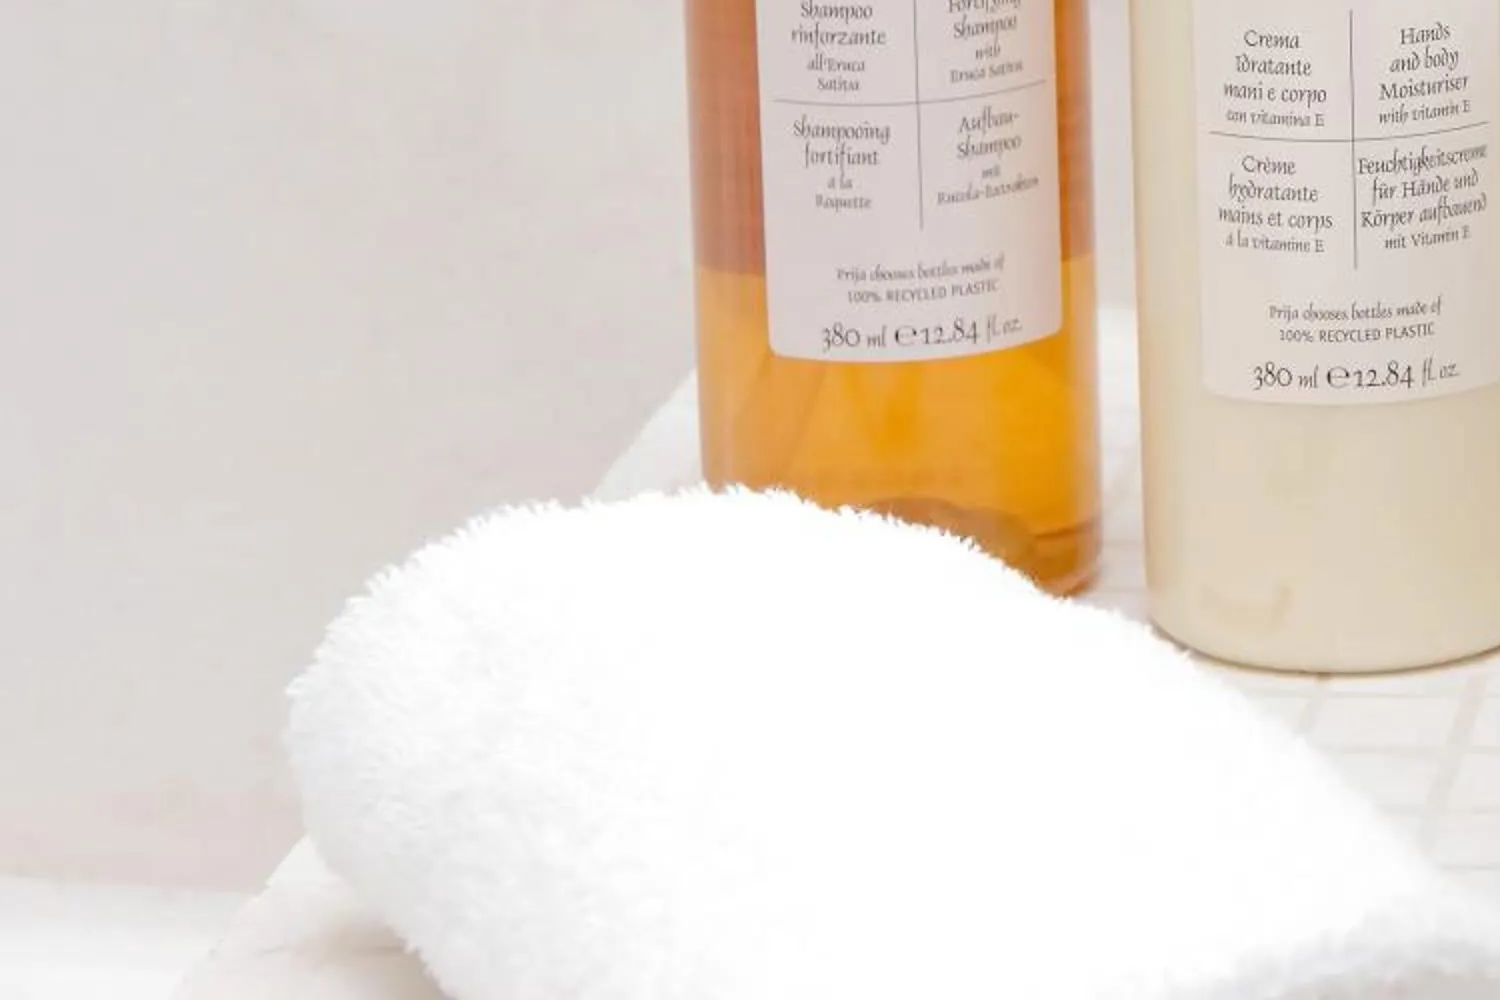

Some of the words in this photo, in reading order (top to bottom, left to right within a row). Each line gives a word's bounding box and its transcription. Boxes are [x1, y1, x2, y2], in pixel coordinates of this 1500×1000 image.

[792, 22, 886, 52] rinforzante
[954, 15, 1017, 44] Shampoo
[1244, 30, 1300, 49] Crema
[1400, 22, 1451, 45] Hands
[1389, 55, 1420, 73] and
[1424, 46, 1459, 72] body
[1224, 82, 1263, 100] mani
[1267, 88, 1276, 100] e
[1281, 87, 1327, 108] corpo
[1379, 74, 1469, 100] Moisturiser
[1226, 109, 1246, 122] con
[1251, 109, 1310, 127] vitamina
[1315, 114, 1324, 126] E
[1379, 103, 1409, 125] with
[1412, 102, 1459, 120] vitamin
[1462, 100, 1471, 113] E
[793, 114, 891, 145] Shampooing
[805, 142, 880, 174] fortifiant
[957, 135, 1022, 160] Shampoo
[1242, 156, 1296, 175] Crème
[1229, 172, 1318, 203] hydratante
[1373, 176, 1394, 206] für
[1402, 178, 1449, 199] Hände
[1455, 168, 1479, 188] und
[816, 195, 872, 212] Roquette
[1361, 209, 1413, 232] Körper
[1419, 193, 1488, 225] aufbauend
[1219, 207, 1263, 225] mains
[1267, 208, 1282, 226] et
[1288, 214, 1334, 233] corps
[1237, 230, 1249, 248] la
[1252, 236, 1311, 252] vitamine
[1315, 240, 1324, 252] E
[1385, 236, 1406, 249] mit
[1410, 230, 1459, 247] Vitamin
[1462, 226, 1471, 238] E
[837, 269, 866, 282] Prija
[870, 264, 914, 282] chooses
[917, 263, 958, 278] bottles
[962, 258, 991, 274] made
[848, 290, 881, 304] 100%
[887, 287, 947, 302] RECYCLED
[951, 280, 999, 296] PLASTIC
[1269, 305, 1299, 321] Prija
[1302, 303, 1348, 321] chooses
[1352, 304, 1392, 321] bottles
[1396, 301, 1427, 315] made
[1431, 293, 1442, 314] of
[822, 322, 861, 352] 380
[867, 325, 887, 348] ml
[1280, 329, 1313, 342] 100%
[1320, 329, 1381, 343] RECYCLED
[1386, 322, 1435, 339] PLASTIC
[1253, 361, 1292, 389] 380
[1298, 366, 1318, 388] ml
[1353, 360, 1414, 388] 12.84
